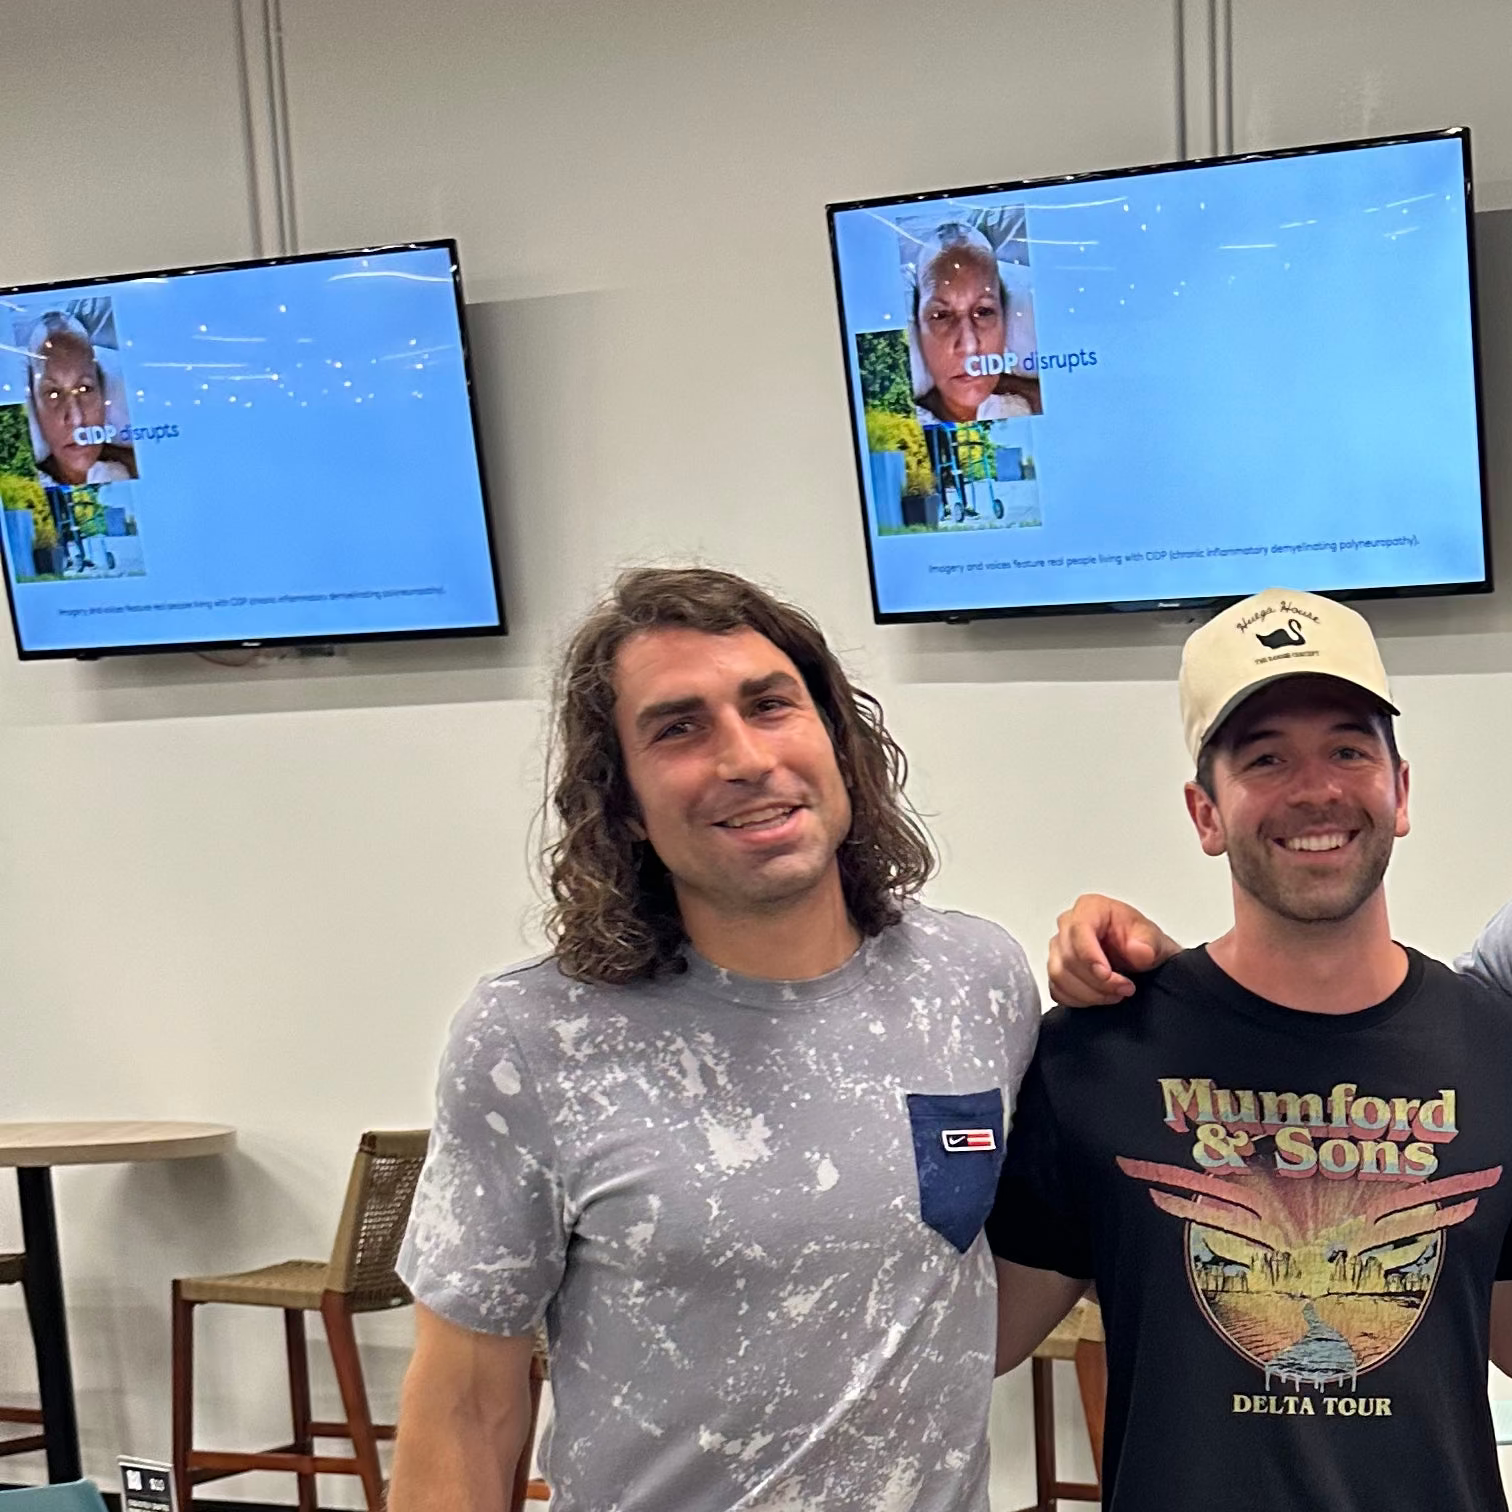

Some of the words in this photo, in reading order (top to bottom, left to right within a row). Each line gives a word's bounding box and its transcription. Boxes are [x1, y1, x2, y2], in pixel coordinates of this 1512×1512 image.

[964, 351, 1019, 377] CIDP
[1023, 349, 1098, 373] disrupts
[73, 424, 117, 446] CIDP
[1158, 1078, 1459, 1141] Mumford
[1192, 1123, 1256, 1174] &
[1274, 1126, 1440, 1181] Sons
[1232, 1394, 1316, 1416] DELTA
[1324, 1396, 1393, 1417] TOUR
